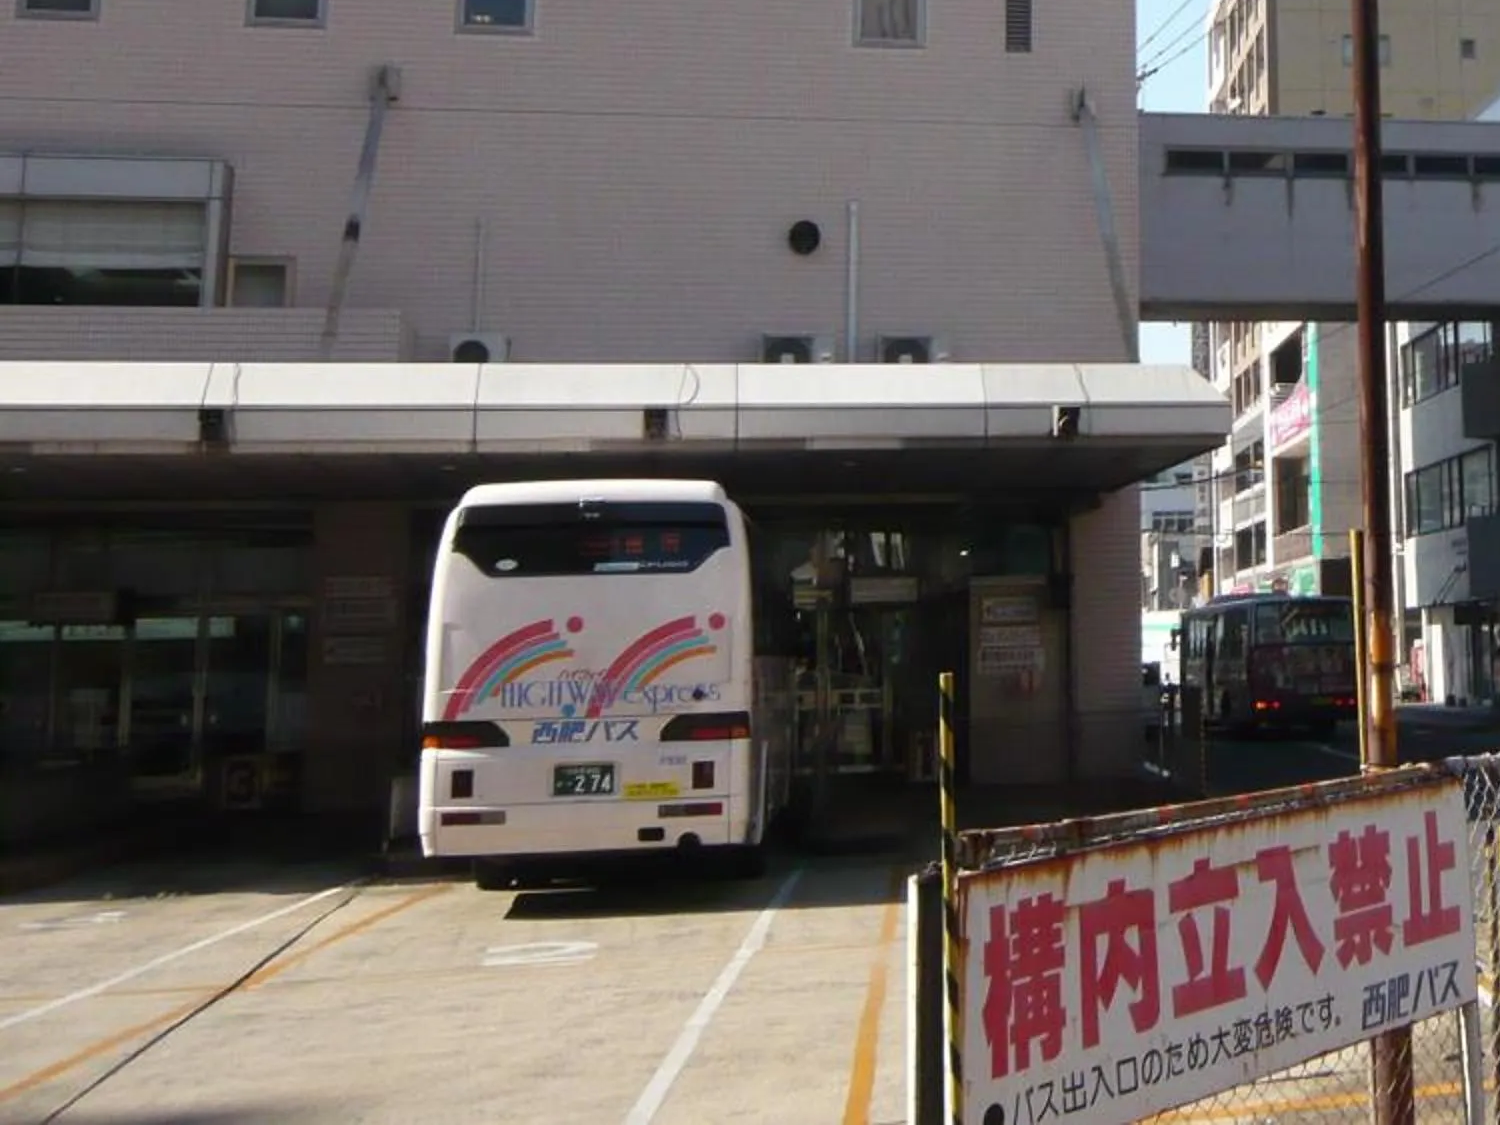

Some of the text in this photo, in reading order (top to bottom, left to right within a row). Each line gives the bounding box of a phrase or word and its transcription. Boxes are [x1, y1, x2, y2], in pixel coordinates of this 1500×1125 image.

[532, 721, 639, 744] 西肥バス
[982, 810, 1461, 1079] 構内立入禁止
[1361, 960, 1461, 1031] 西肥バス
